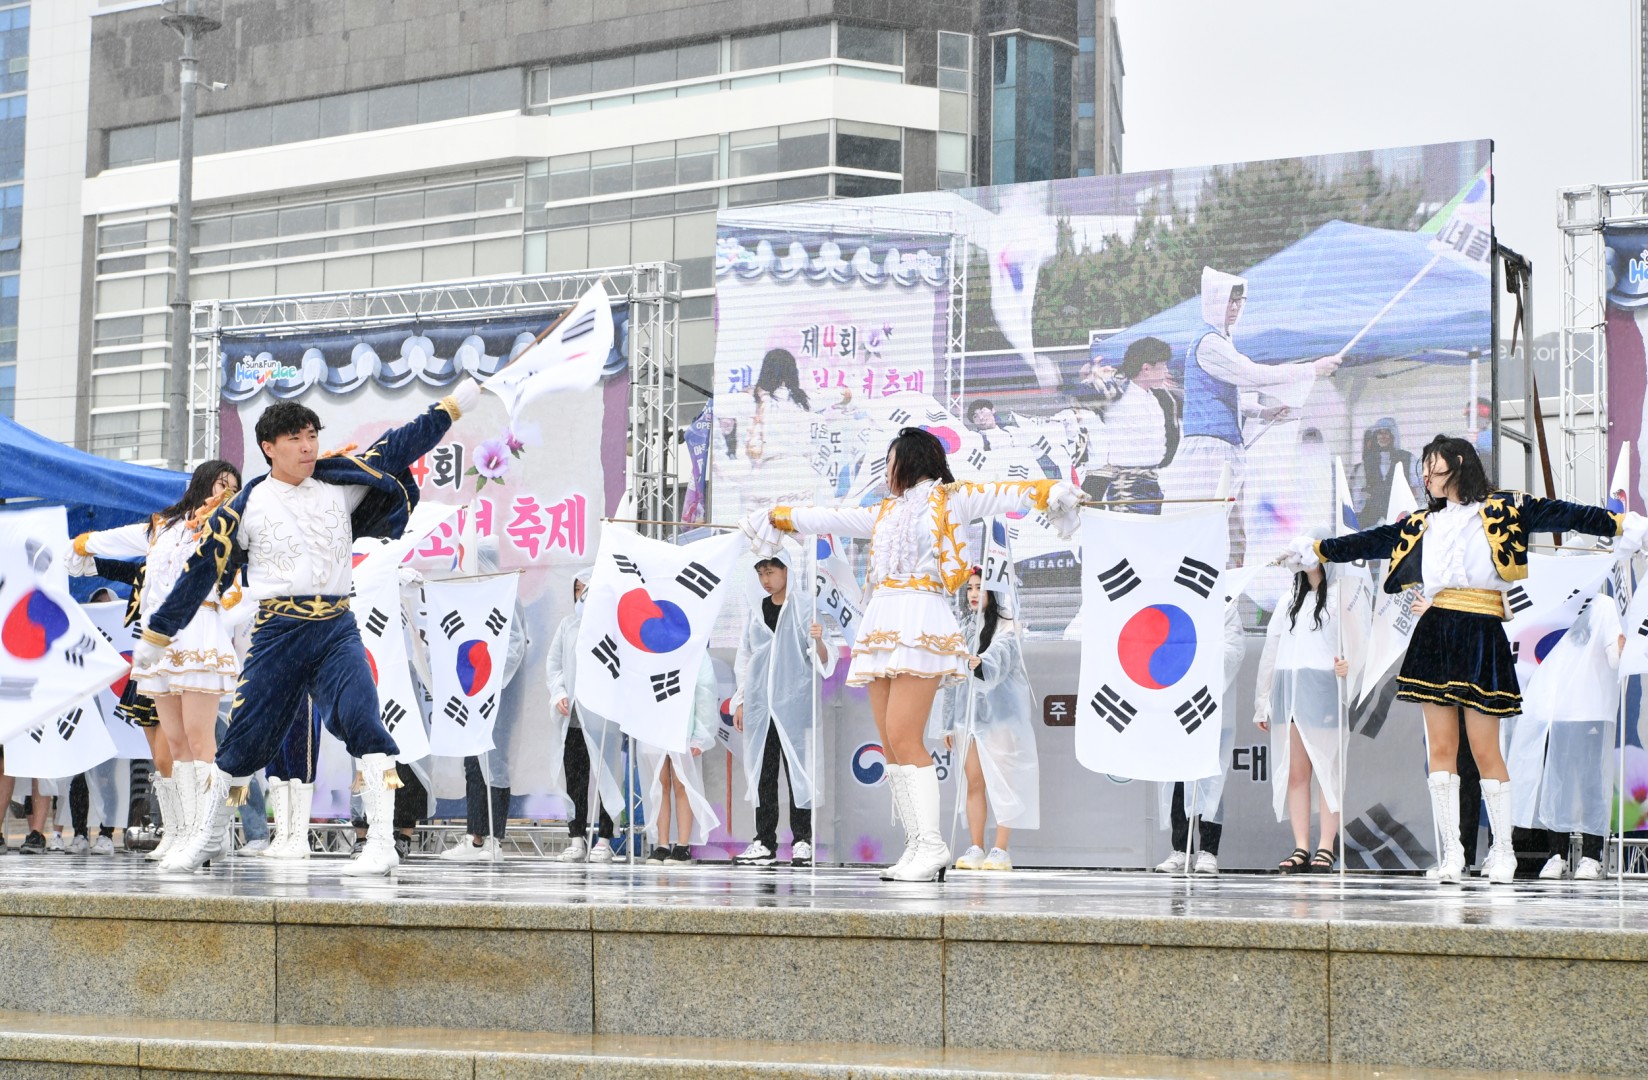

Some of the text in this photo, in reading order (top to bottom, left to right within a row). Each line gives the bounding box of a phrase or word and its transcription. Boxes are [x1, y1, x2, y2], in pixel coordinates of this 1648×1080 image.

[801, 324, 857, 359] 제4회
[236, 361, 297, 385] Haeundae
[246, 359, 277, 369] Sun&Fun
[506, 494, 586, 560] 축제
[1028, 558, 1075, 569] BEACH
[1049, 701, 1068, 722] 주
[1232, 745, 1267, 781] 대
